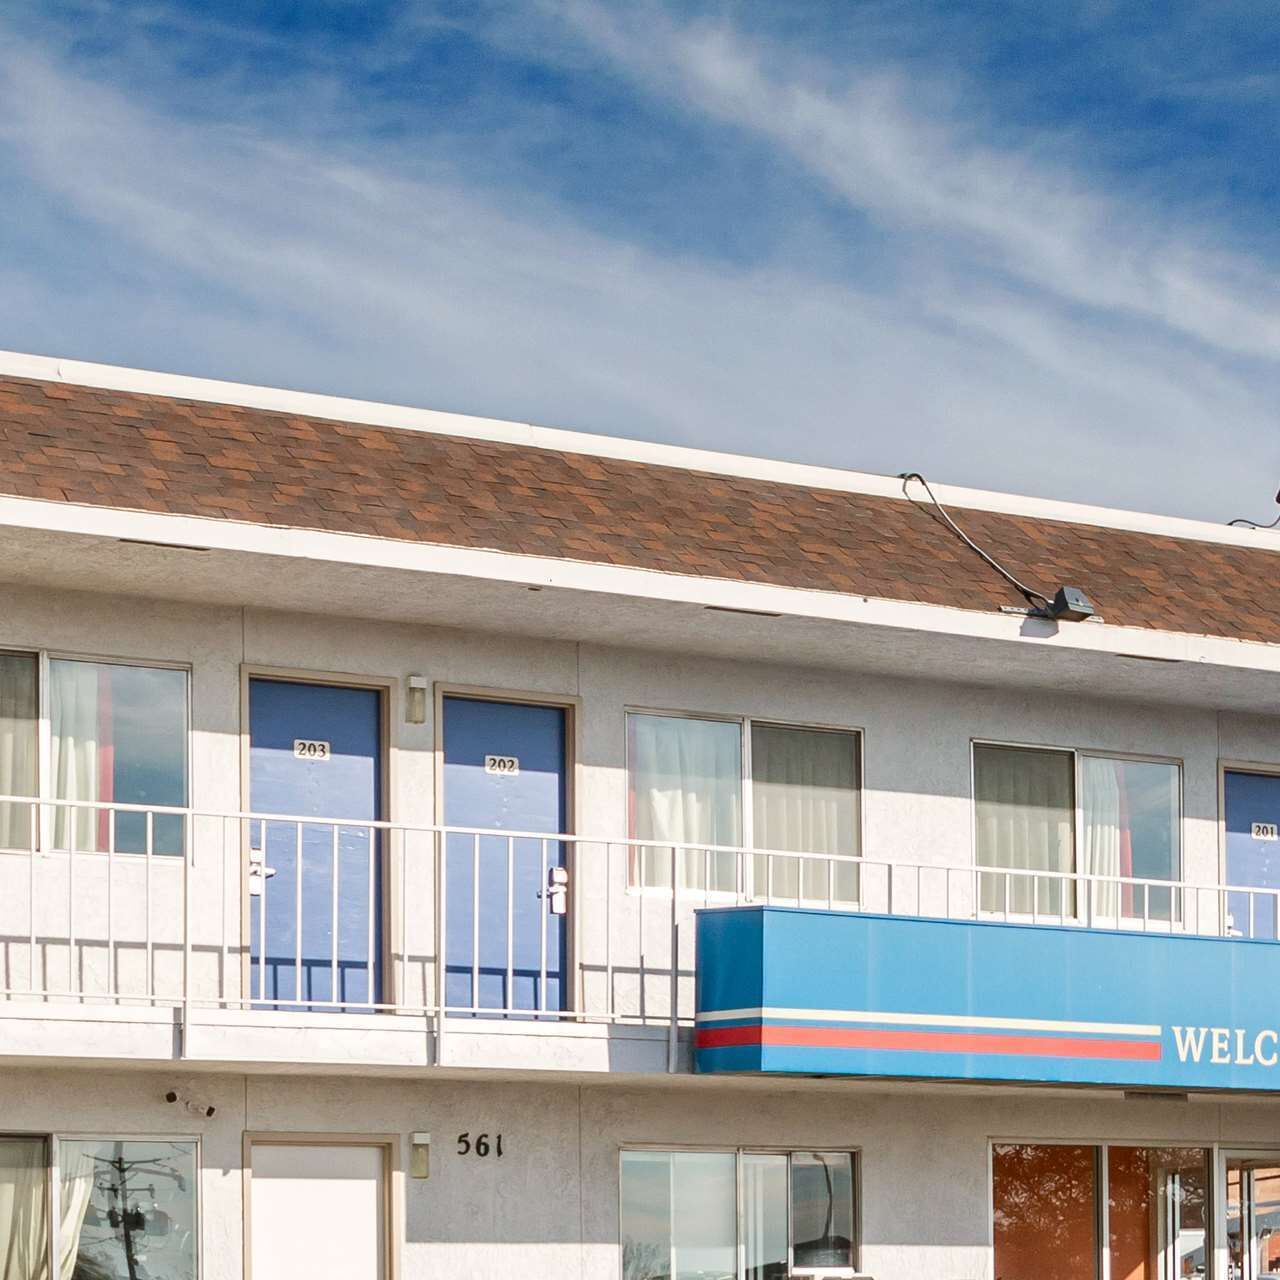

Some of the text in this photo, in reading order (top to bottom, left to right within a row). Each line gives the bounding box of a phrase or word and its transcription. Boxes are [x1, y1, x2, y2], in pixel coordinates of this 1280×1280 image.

[297, 742, 326, 758] 203
[489, 758, 515, 771] 202
[1255, 824, 1274, 837] 201
[457, 1132, 503, 1157] 561
